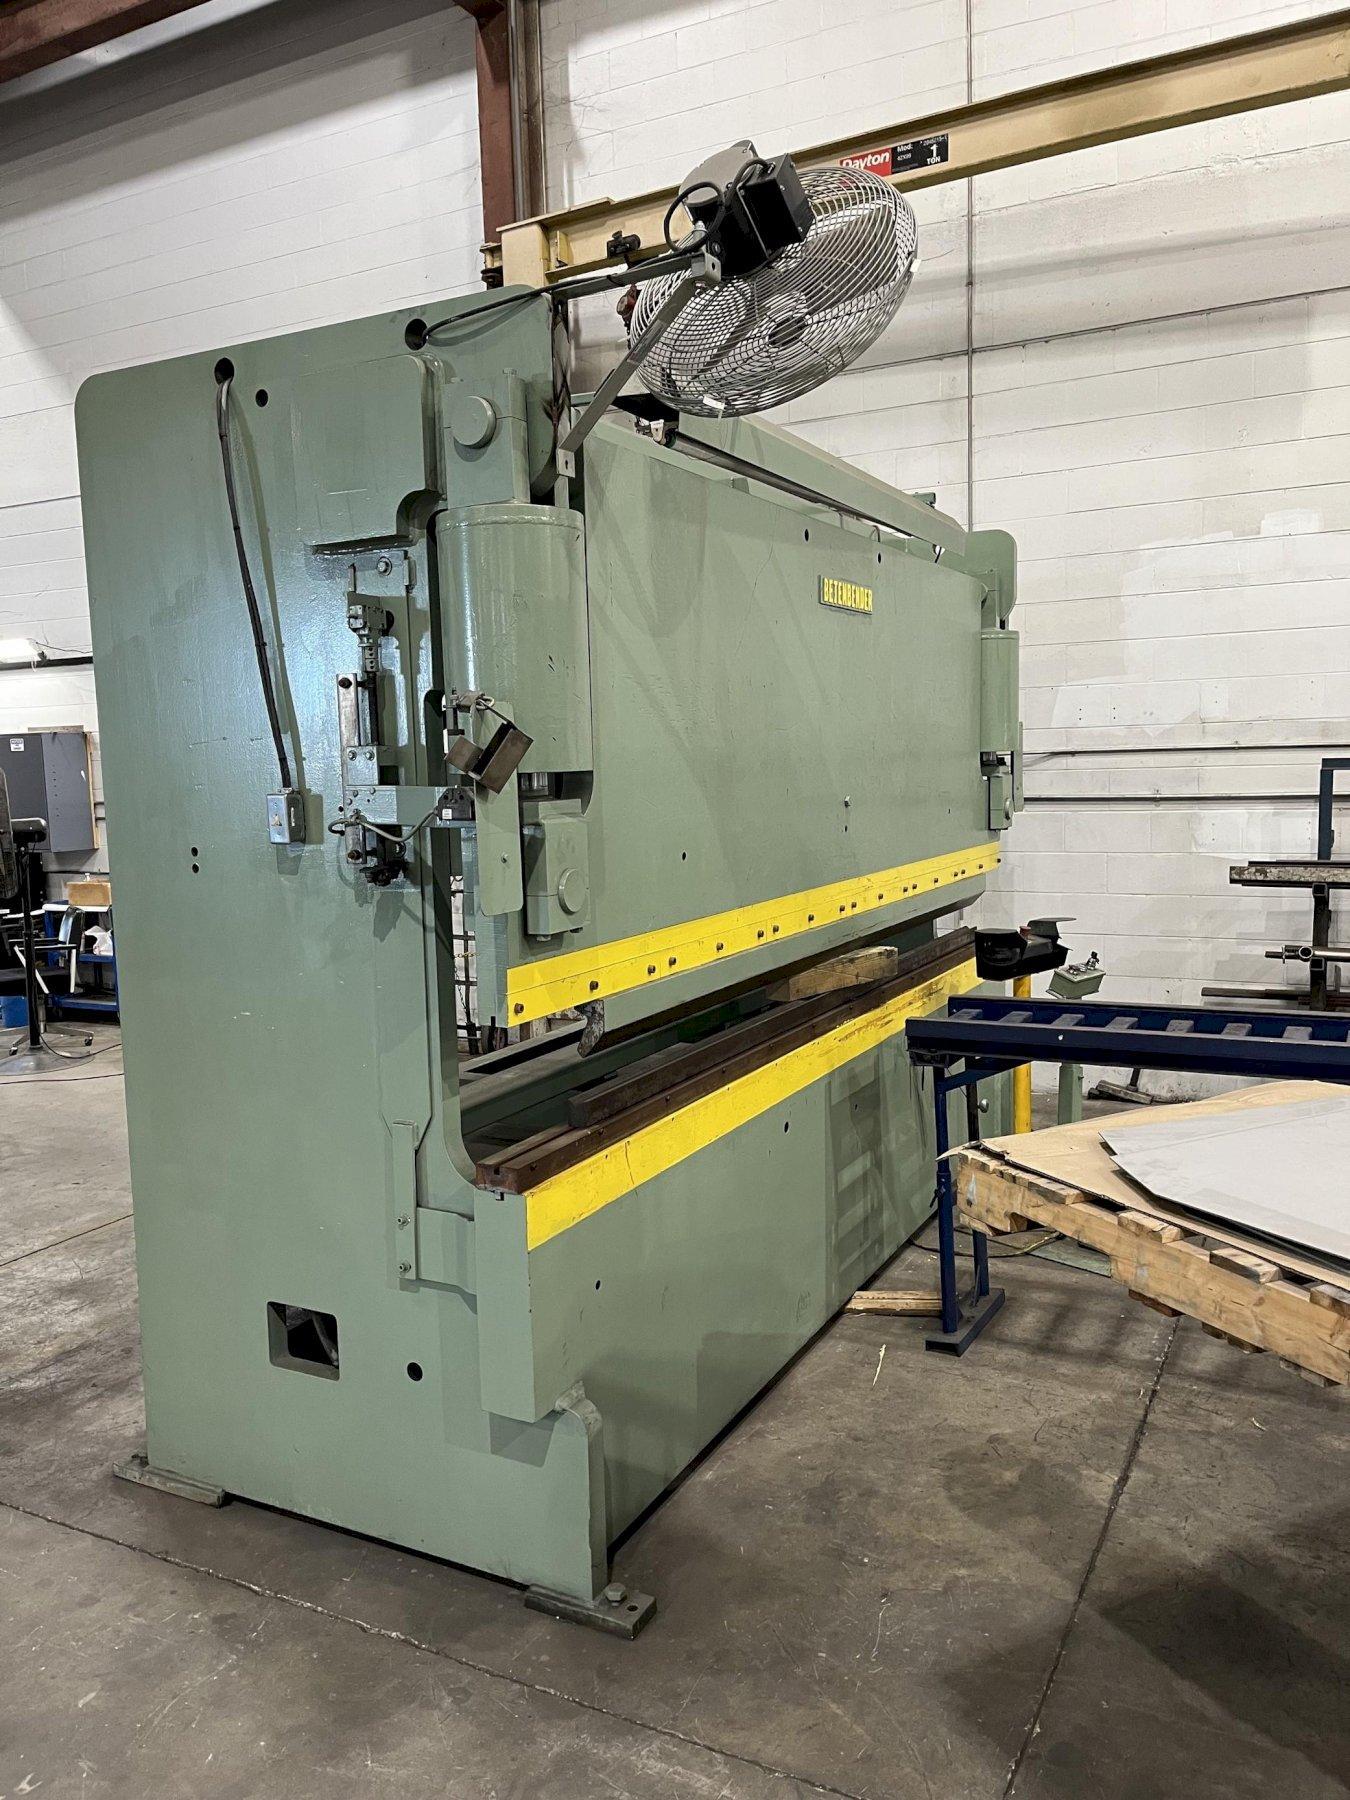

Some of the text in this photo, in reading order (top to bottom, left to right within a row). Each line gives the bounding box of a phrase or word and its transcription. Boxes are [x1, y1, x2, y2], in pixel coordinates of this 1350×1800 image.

[930, 143, 938, 157] 1
[842, 152, 890, 170] Dayton
[927, 156, 941, 164] TON
[823, 577, 873, 612] BETENBENDER
